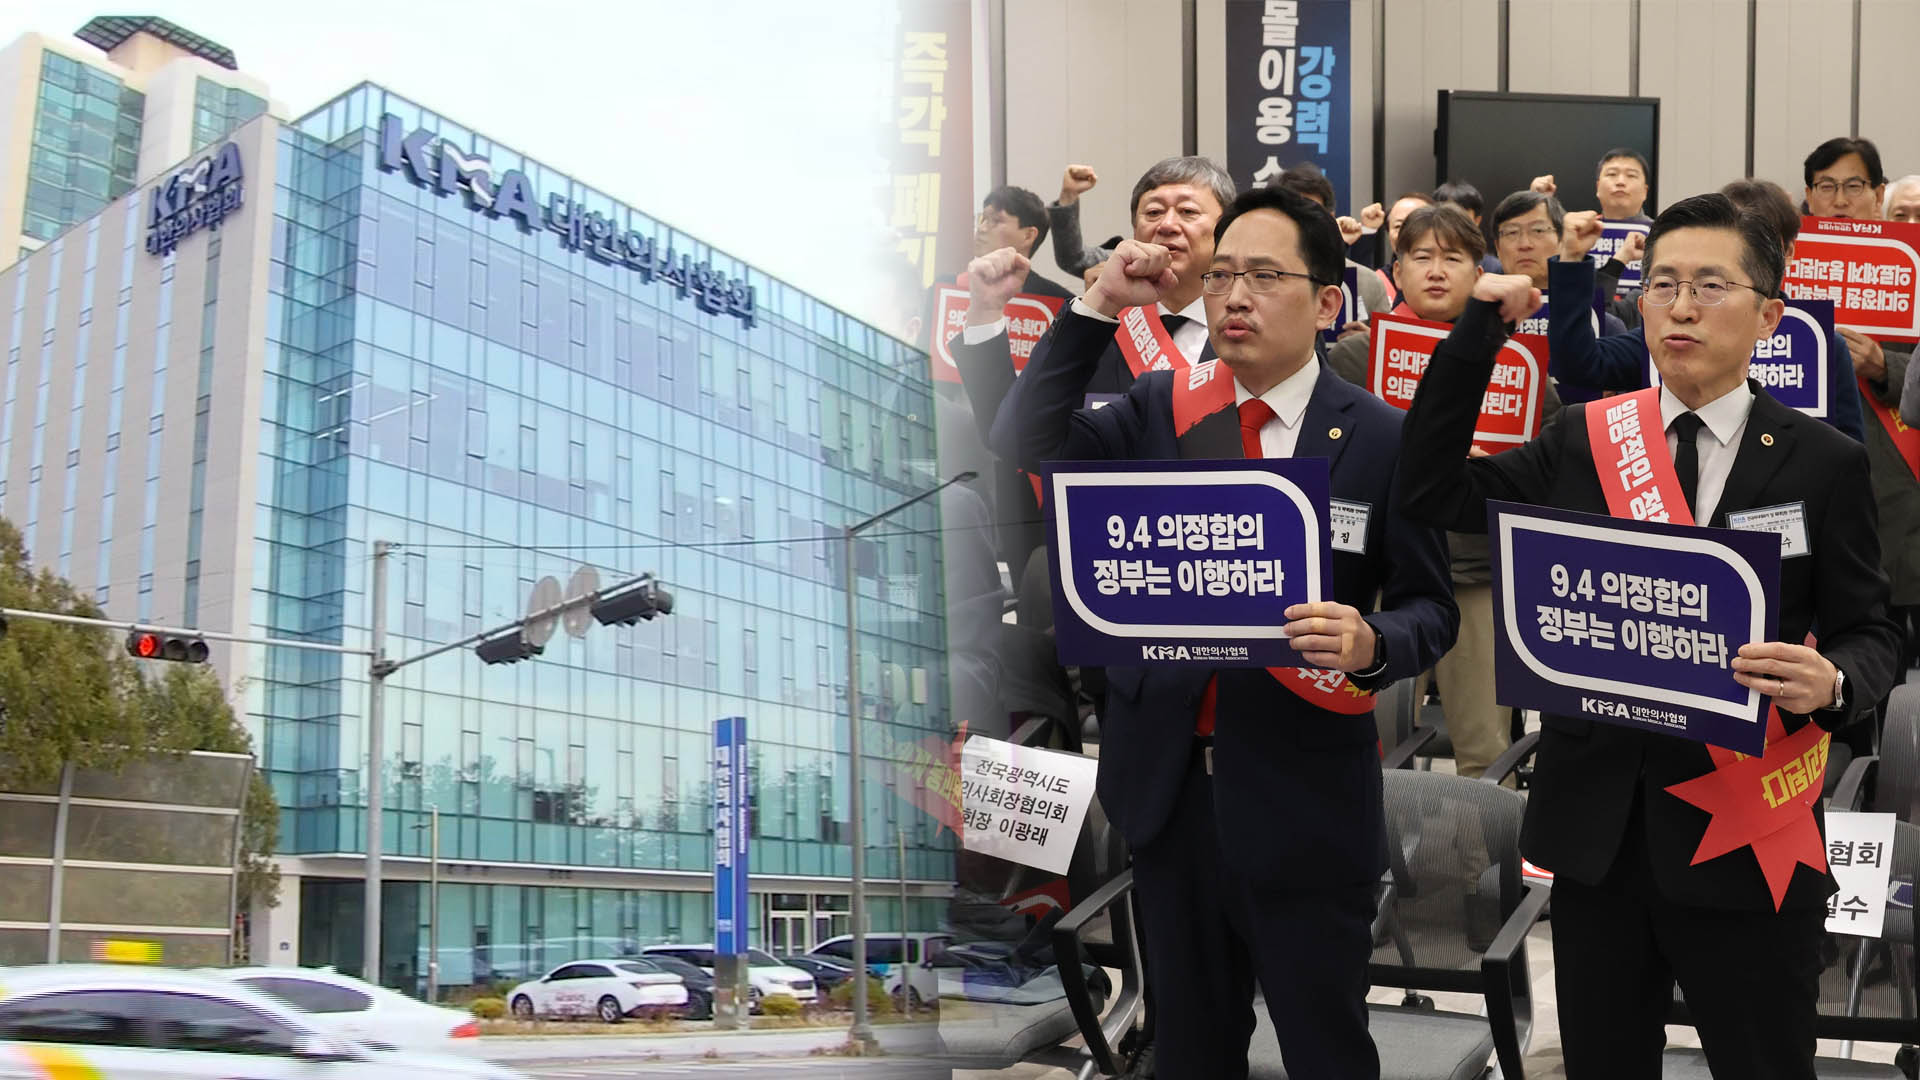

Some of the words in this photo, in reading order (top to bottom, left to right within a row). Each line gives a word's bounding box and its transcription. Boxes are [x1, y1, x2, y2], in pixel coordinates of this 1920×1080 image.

[898, 31, 948, 157] 즉각
[1296, 46, 1336, 154] 강력
[147, 141, 242, 225] KMA
[380, 112, 541, 234] KMA
[548, 191, 758, 328] 대한의사협회
[1847, 261, 1912, 286] 의료체계
[1845, 287, 1910, 312] 의대정원
[1005, 315, 1048, 338] 속확대
[1750, 334, 1792, 359] 합의
[1605, 399, 1655, 492] 일방적인
[1107, 515, 1152, 551] 9.4
[1157, 513, 1264, 551] 의정합의
[1093, 559, 1172, 596] 정부는
[1177, 559, 1285, 597] 이행하라
[1550, 564, 1595, 602] 9.4
[1601, 571, 1708, 622] 의정합의
[1141, 645, 1191, 660] KMA
[1191, 646, 1248, 656] 대한의사협회
[1536, 604, 1616, 651] 정부는
[1621, 619, 1729, 669] 이행하라
[1581, 697, 1631, 719] KMA
[1631, 705, 1687, 725] 대한의사협회
[975, 759, 1071, 794] 전국광역시도
[961, 780, 1069, 823] 의사회장협의회
[962, 808, 993, 831] 회장
[999, 818, 1049, 847] 이광래
[1829, 840, 1883, 868] 협회
